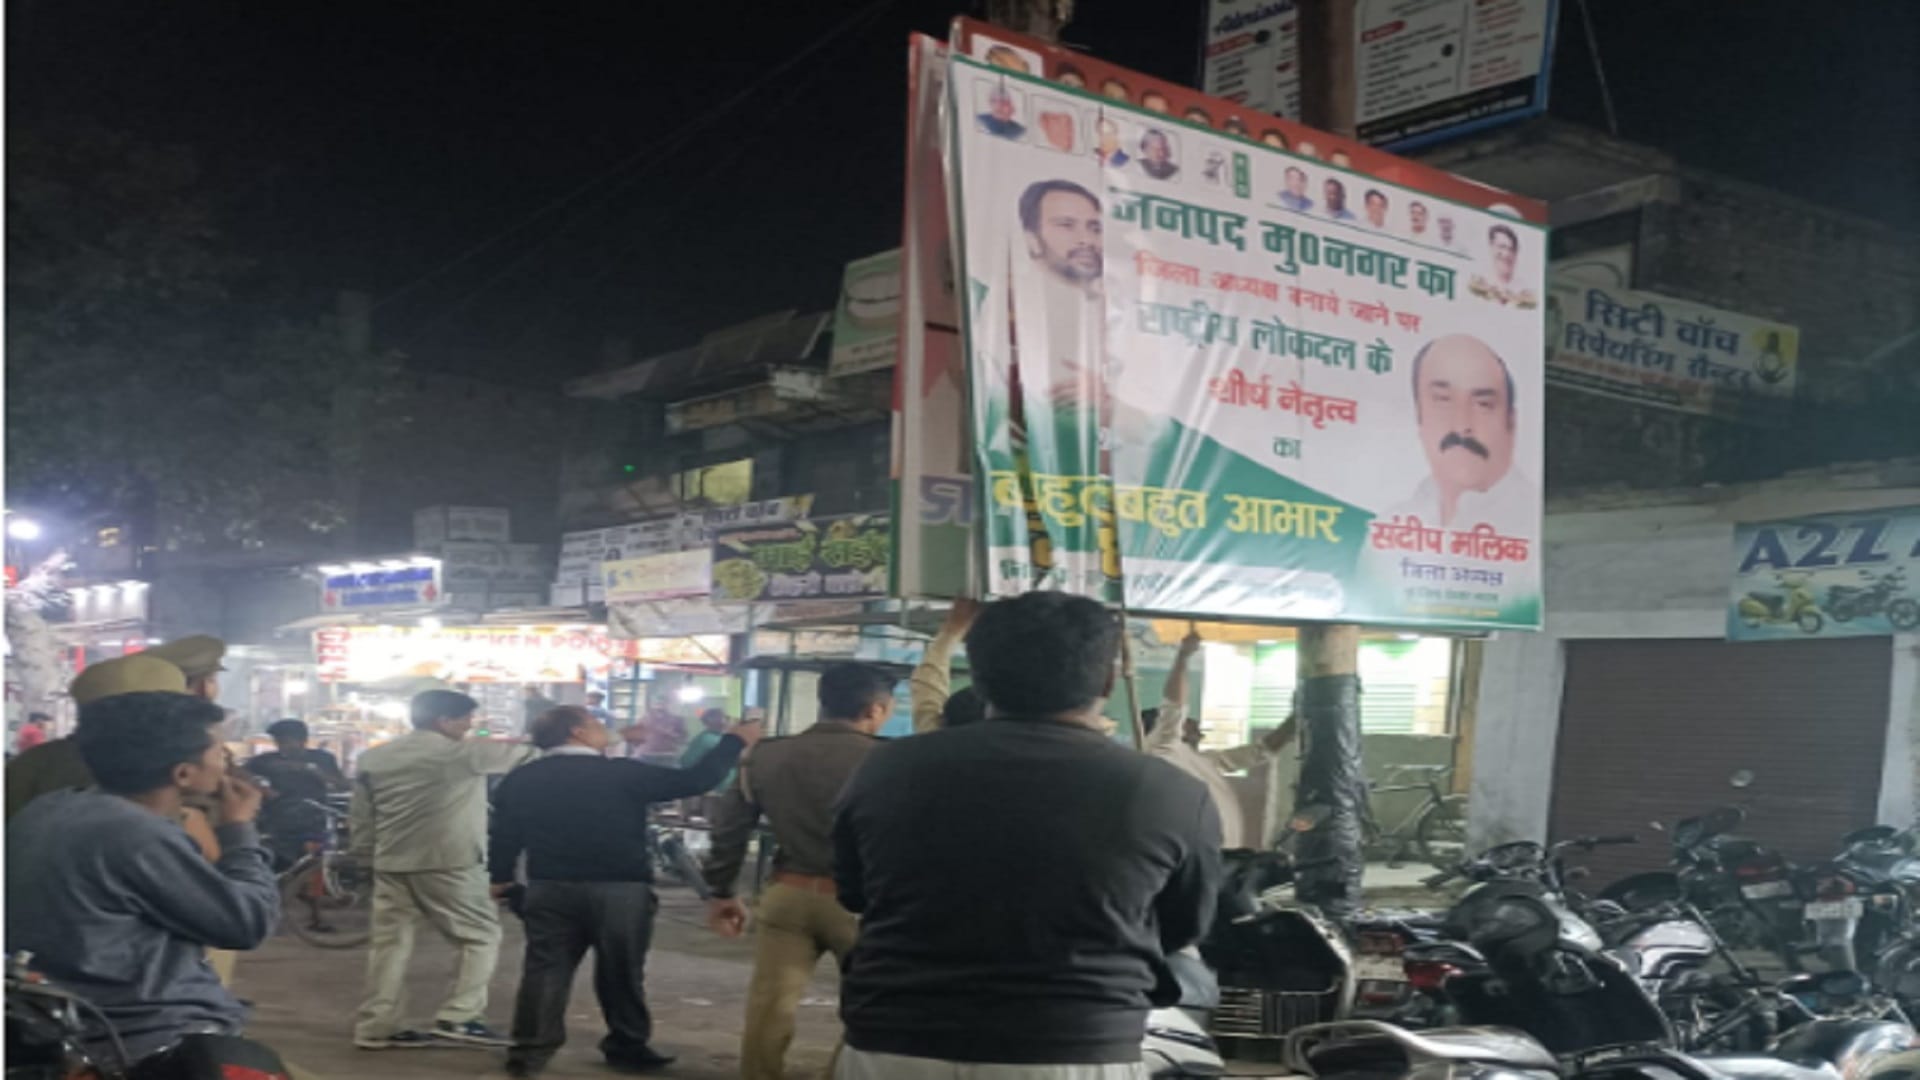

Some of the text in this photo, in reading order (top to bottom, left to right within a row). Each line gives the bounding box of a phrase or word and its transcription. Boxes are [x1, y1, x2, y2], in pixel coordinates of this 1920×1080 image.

[1107, 186, 1248, 251] जनपद
[1417, 259, 1457, 300] का
[1349, 299, 1390, 327] जाने
[1395, 311, 1421, 333] पर
[1585, 288, 1666, 338] सिटी
[1251, 316, 1356, 370] लोकदल
[1366, 337, 1393, 375] के
[1208, 368, 1358, 430] शीर्ष नेतृत्व
[1272, 436, 1303, 460] का
[1114, 484, 1209, 539] बहुत
[1224, 493, 1345, 543] आभार
[1370, 514, 1531, 563] संदीप मलिक
[1739, 518, 1891, 573] A2Z
